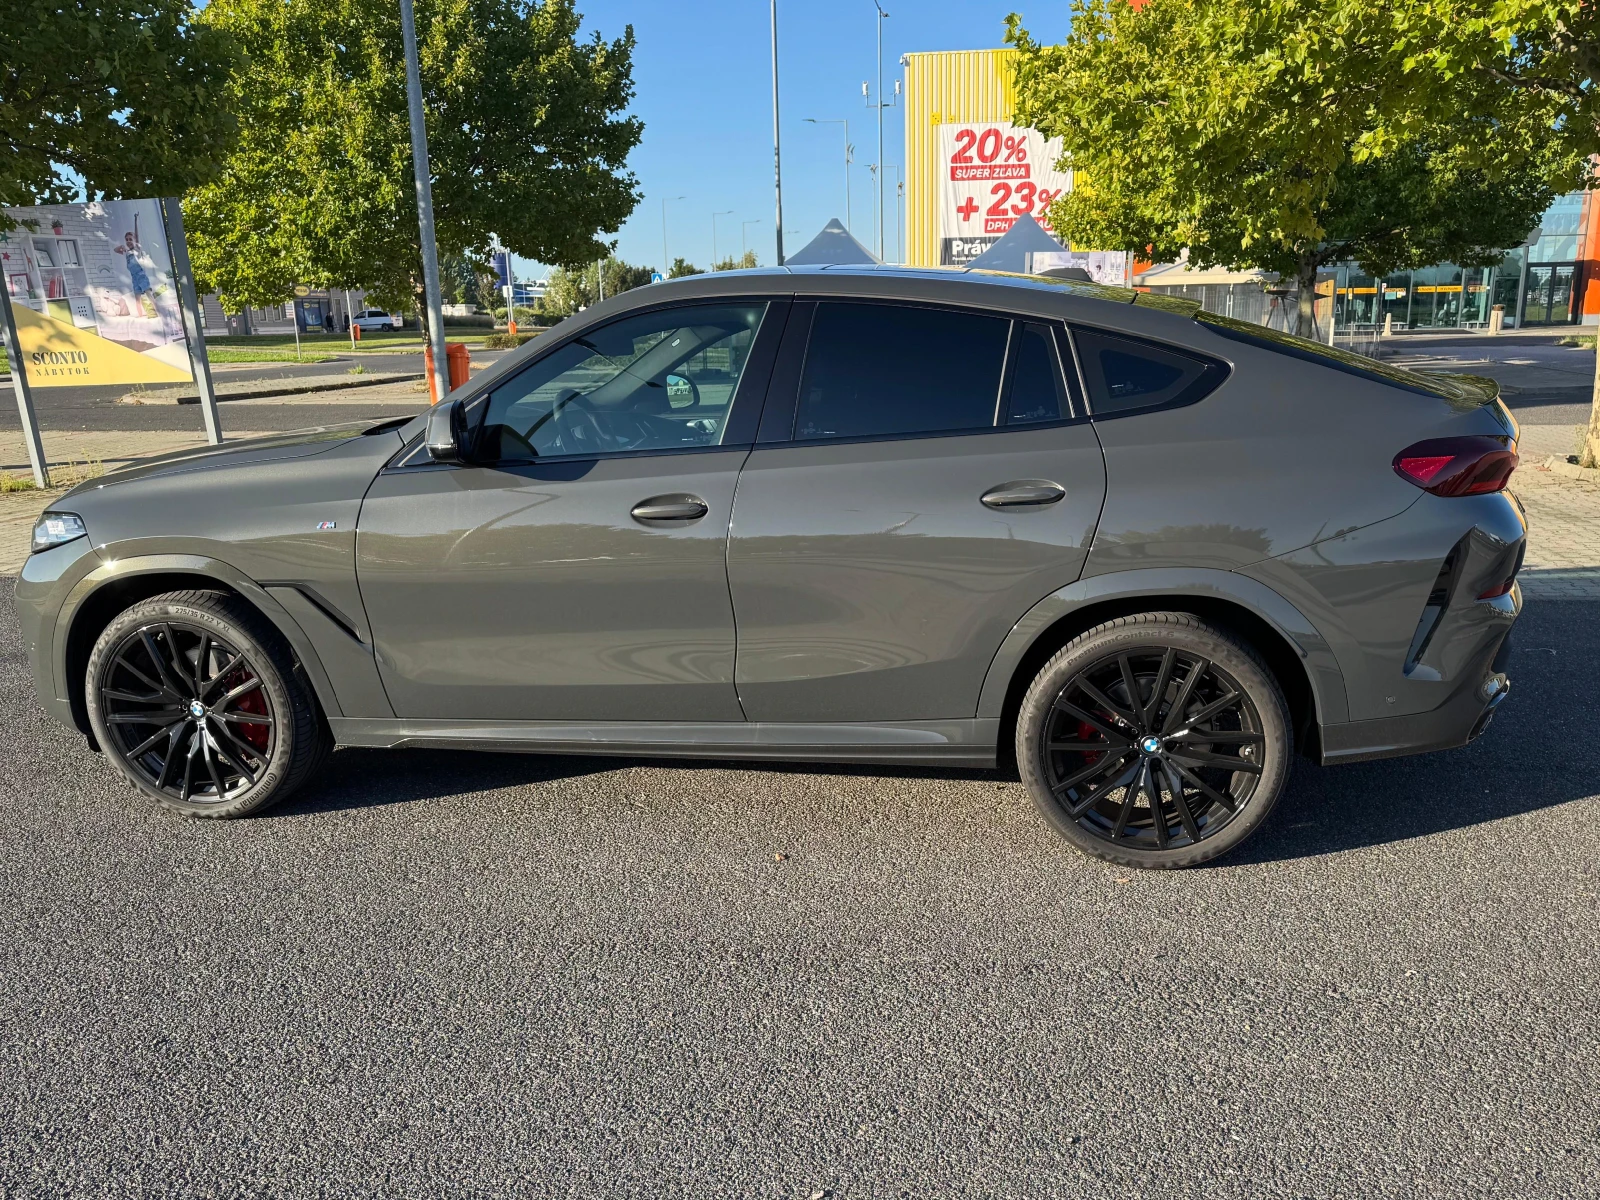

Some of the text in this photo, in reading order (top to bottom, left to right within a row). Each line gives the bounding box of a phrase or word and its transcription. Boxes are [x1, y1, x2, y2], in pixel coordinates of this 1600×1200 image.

[951, 128, 1027, 164] 20%
[955, 168, 990, 179] SUPER
[986, 181, 1062, 217] 23%
[986, 221, 1010, 231] DPH
[32, 350, 88, 366] SCONTO
[36, 366, 90, 377] NÁBYTOK
[175, 607, 199, 618] 275/35
[222, 623, 231, 633] XL
[1066, 630, 1175, 667] PremiumContact 6
[239, 772, 277, 810] Continental
